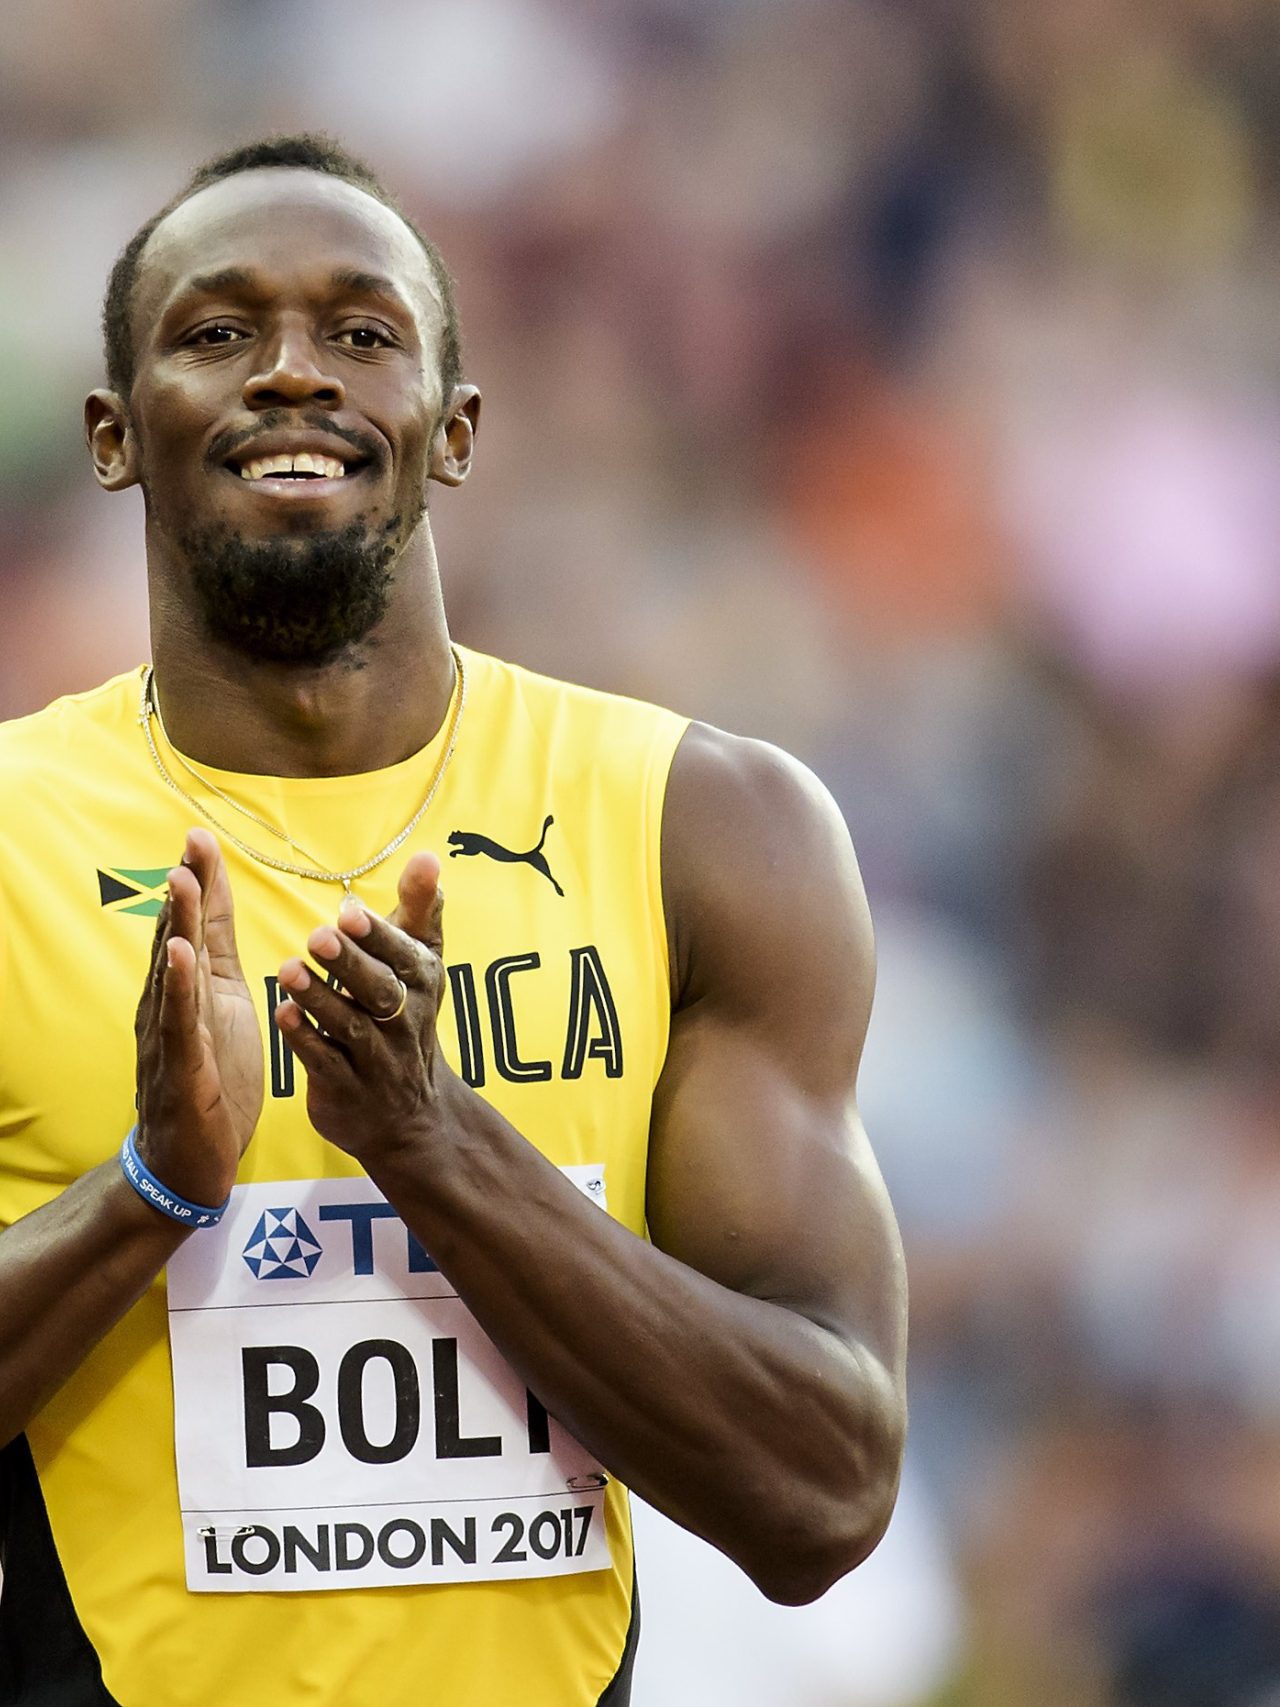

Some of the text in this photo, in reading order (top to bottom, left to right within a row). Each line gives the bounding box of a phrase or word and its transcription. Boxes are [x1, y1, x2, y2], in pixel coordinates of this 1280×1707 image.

[139, 1178, 174, 1210] SPEAK
[173, 1204, 192, 1217] UP
[204, 1505, 596, 1575] LONDON 2017
